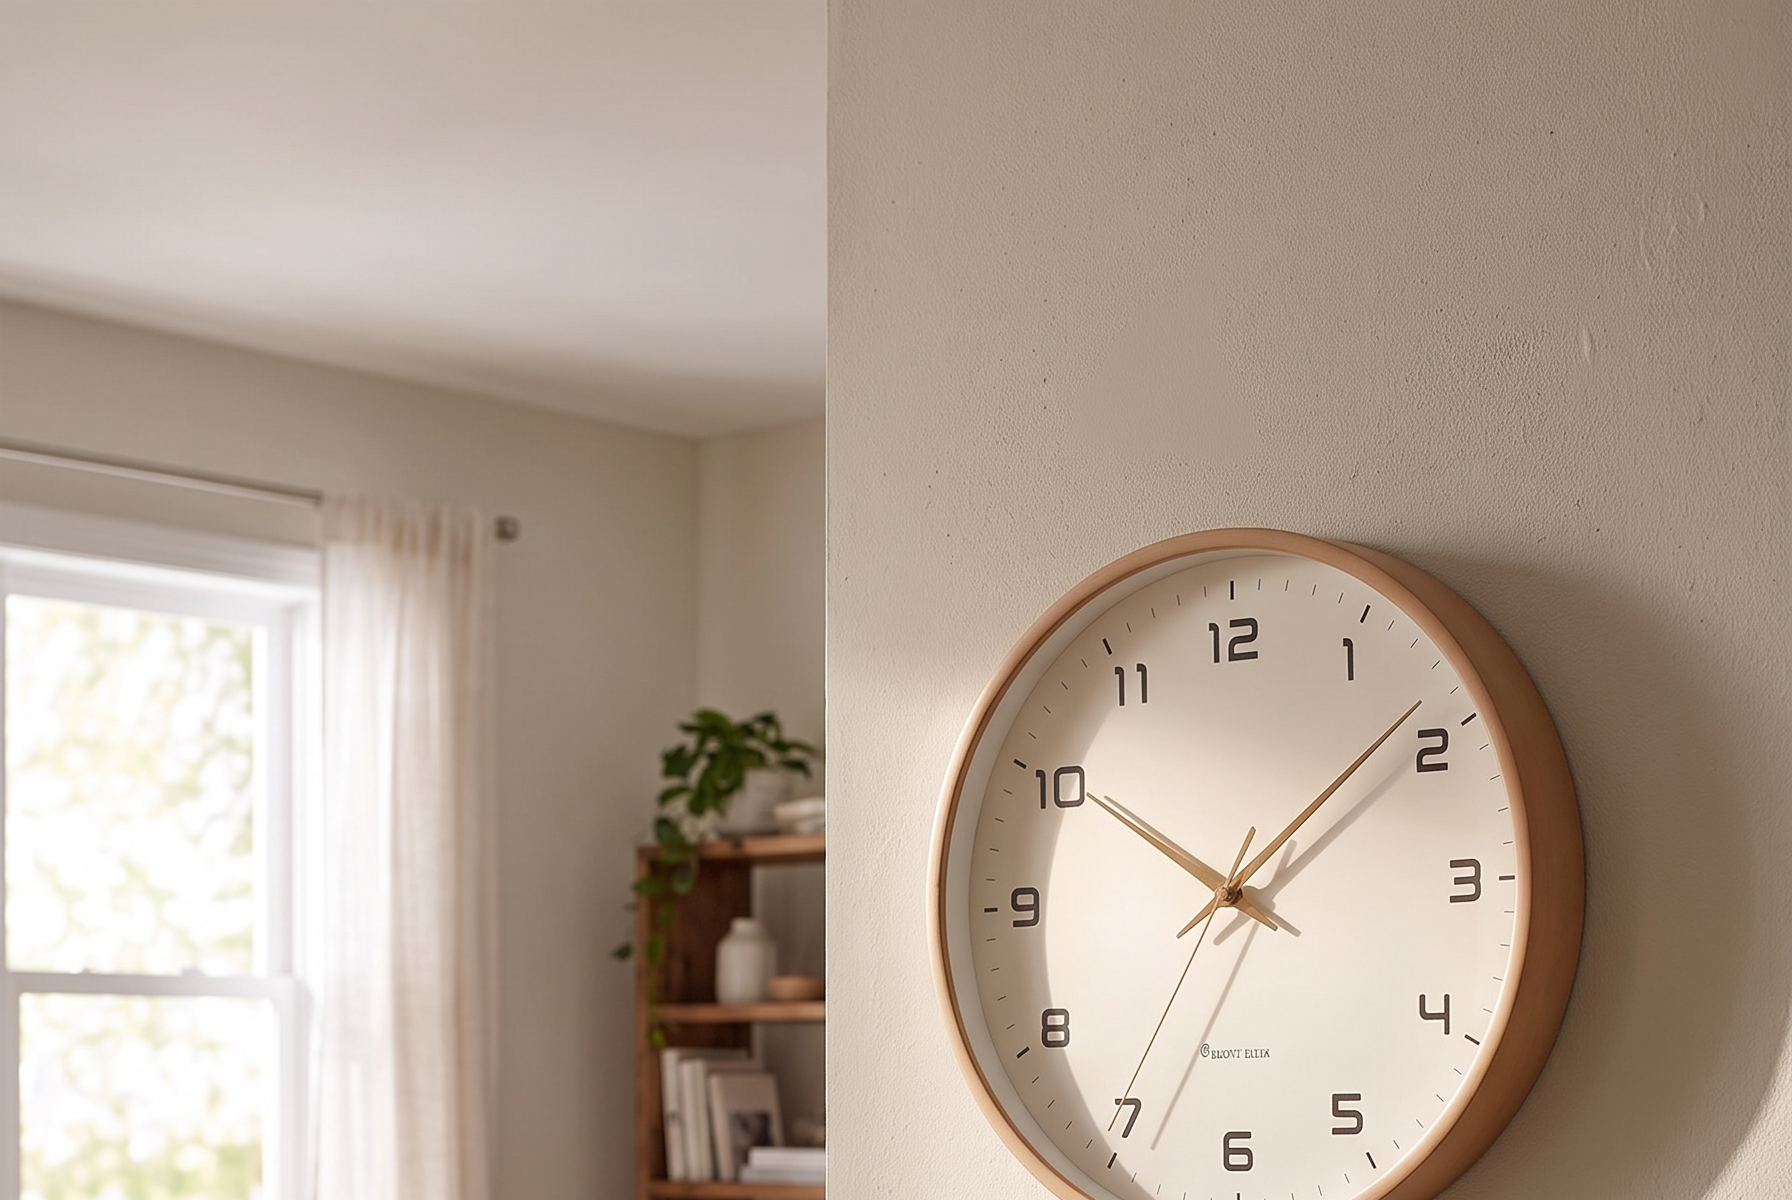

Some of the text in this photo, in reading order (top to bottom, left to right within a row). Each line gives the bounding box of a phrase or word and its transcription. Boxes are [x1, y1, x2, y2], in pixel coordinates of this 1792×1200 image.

[1208, 617, 1259, 663] 12
[1342, 637, 1355, 681] 1
[1114, 662, 1149, 706] 11
[1415, 727, 1449, 773] 2
[1035, 765, 1086, 809] 10
[1449, 858, 1482, 903] 3
[1010, 886, 1040, 928] 9
[1041, 1008, 1070, 1048] 8
[1418, 993, 1450, 1035] 4
[1114, 1097, 1142, 1138] 7
[1331, 1093, 1364, 1136] 5
[1223, 1131, 1254, 1172] 6
